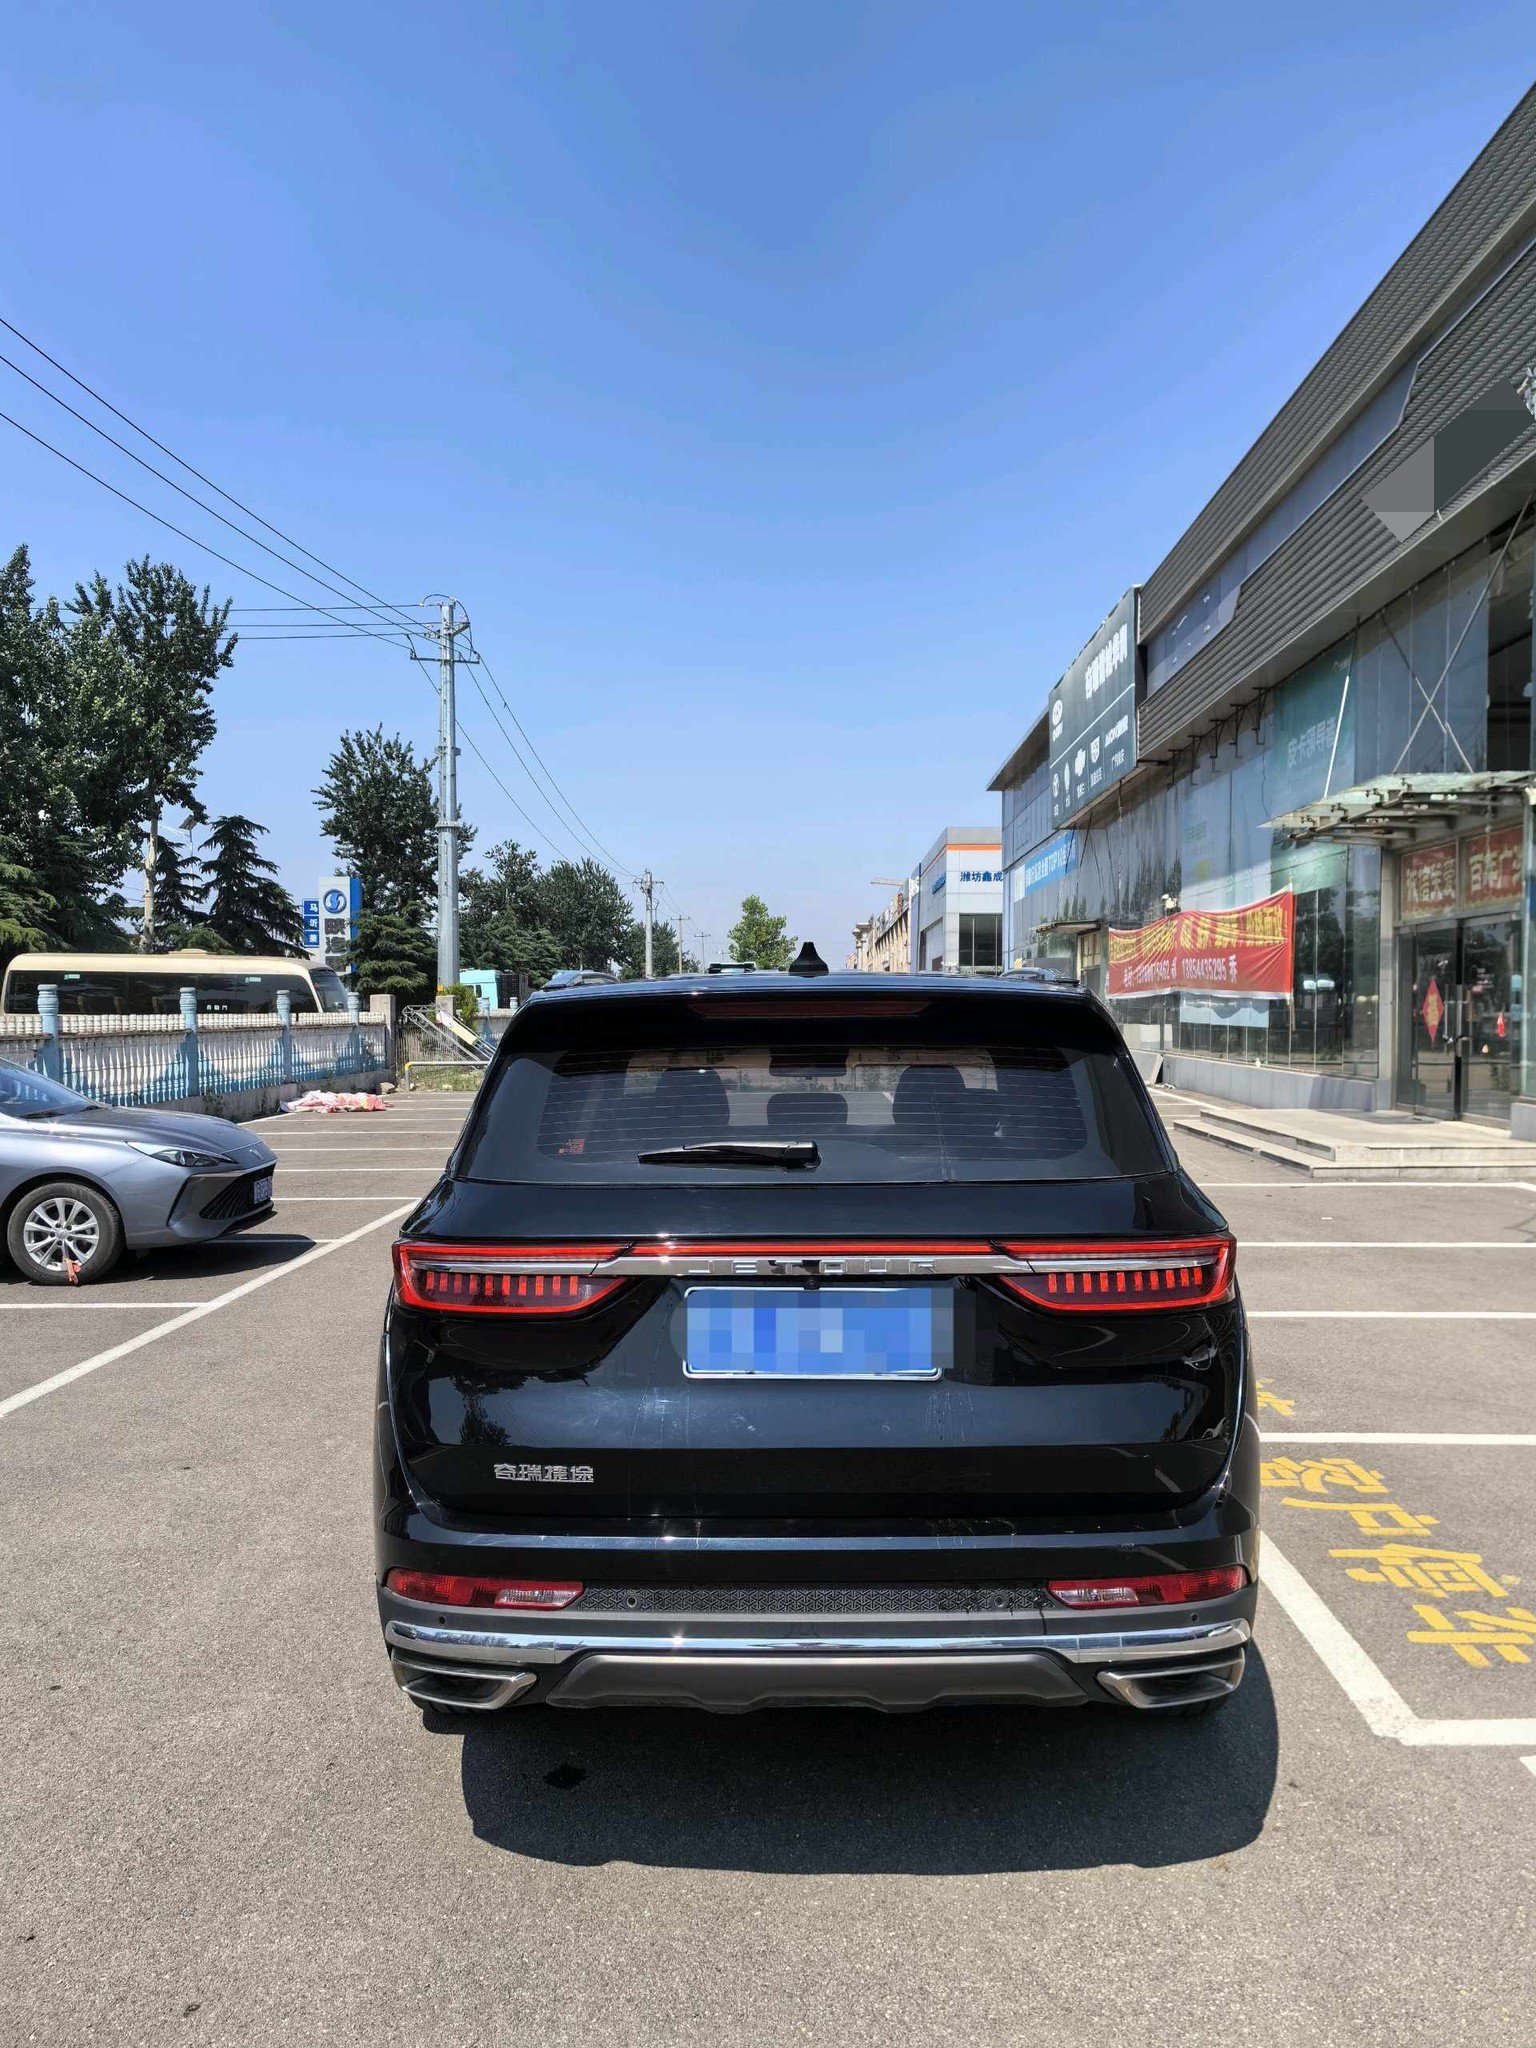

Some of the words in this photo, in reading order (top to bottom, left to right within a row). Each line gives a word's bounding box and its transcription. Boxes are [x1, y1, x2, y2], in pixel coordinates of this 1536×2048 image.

[688, 1259, 937, 1274] JETOUR
[493, 1463, 595, 1483] 奇瑞捷途
